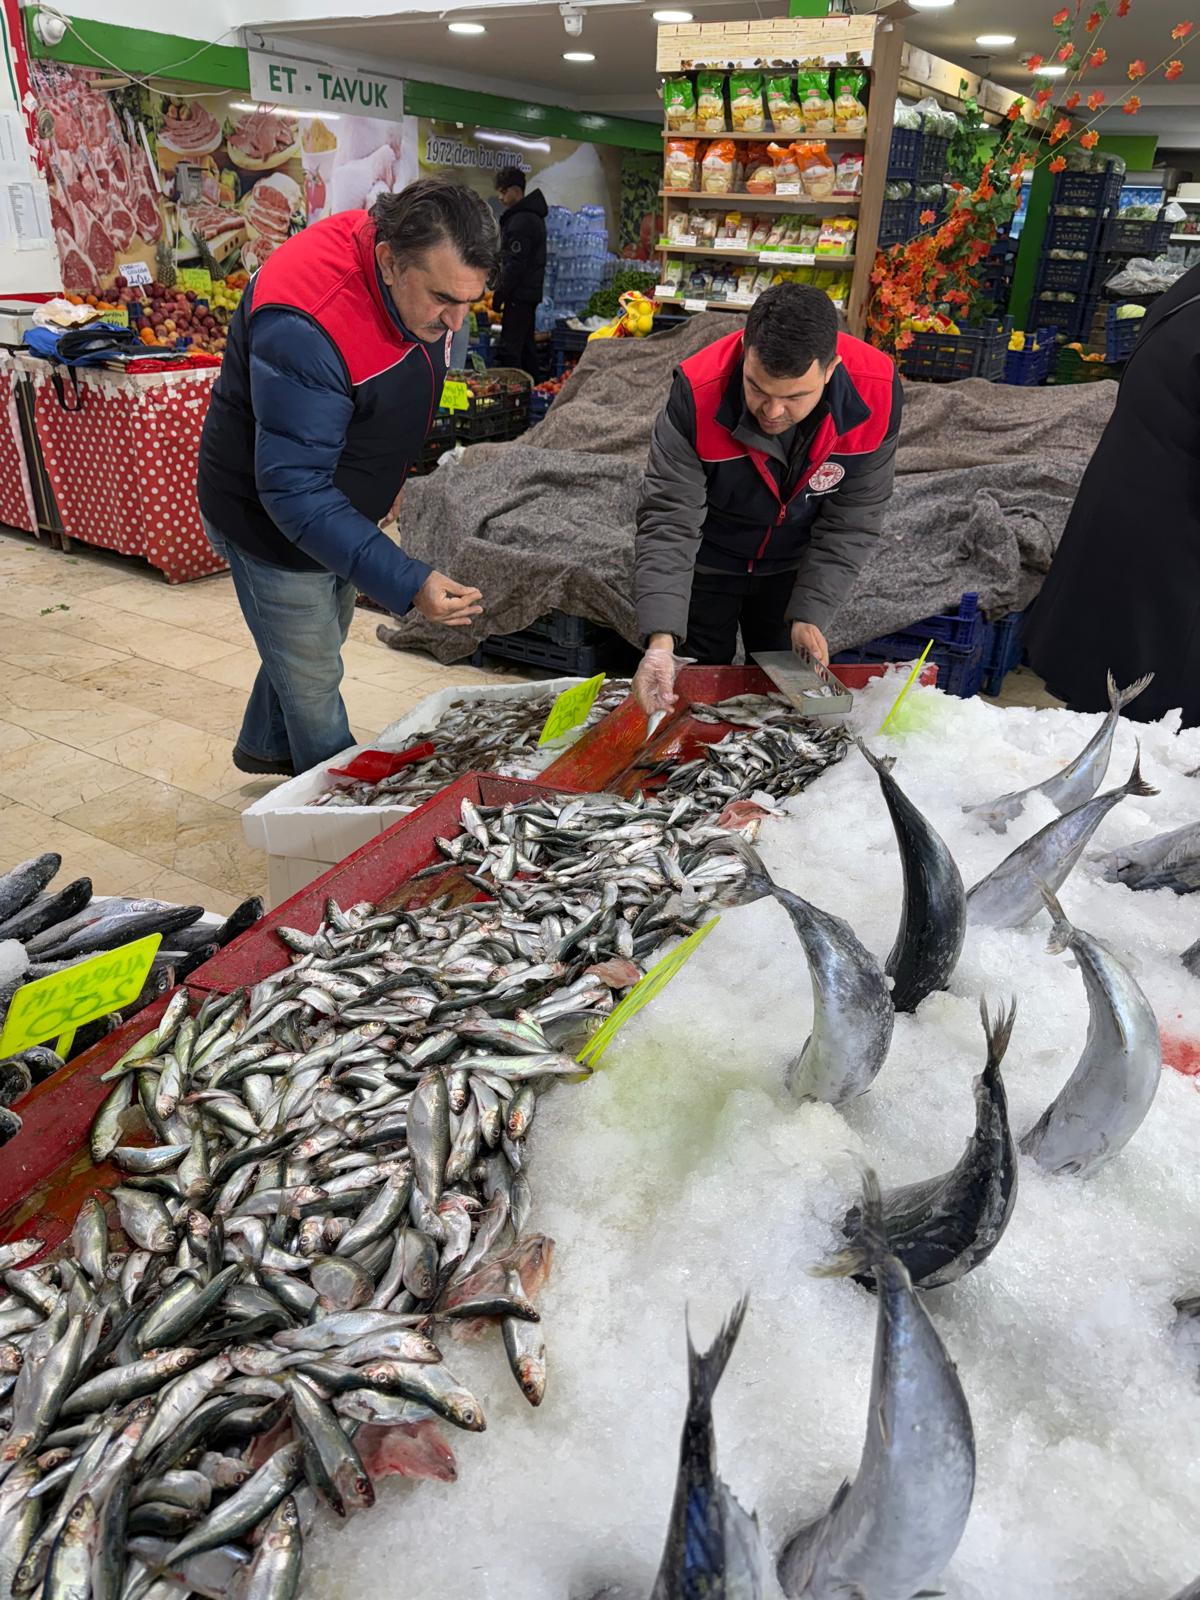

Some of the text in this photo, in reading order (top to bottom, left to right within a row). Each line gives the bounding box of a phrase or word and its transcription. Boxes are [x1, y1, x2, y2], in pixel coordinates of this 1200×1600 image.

[269, 64, 297, 94] ET
[317, 73, 388, 109] TAVUK
[479, 146, 493, 167] bu
